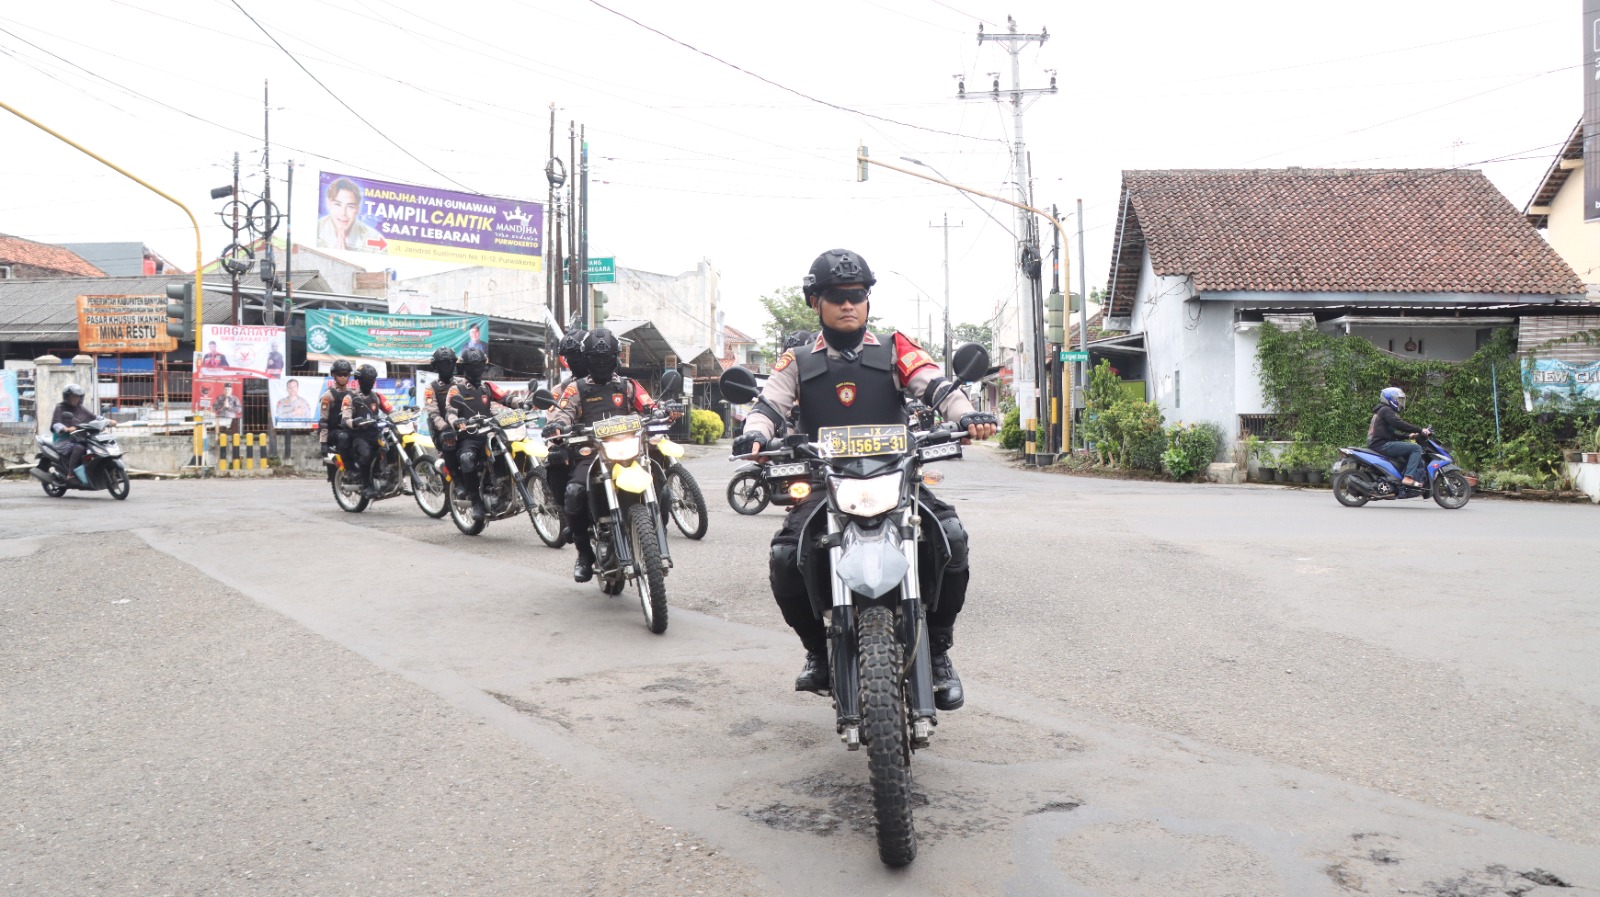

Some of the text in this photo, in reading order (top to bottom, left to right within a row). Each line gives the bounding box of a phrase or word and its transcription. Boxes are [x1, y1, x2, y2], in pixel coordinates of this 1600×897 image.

[365, 188, 497, 214] MANDJHA IVAN GUNAWAN
[365, 201, 494, 232] TAMPIL CANTIK
[382, 222, 480, 244] SAAT LEBARAN
[496, 223, 538, 235] MANDJHA
[494, 238, 539, 249] PURWOKERTO
[499, 257, 536, 267] Purwokerto
[117, 297, 143, 305] KABUPATEN
[86, 316, 168, 324] PASAR KHUSUS IKAN HIAS
[100, 325, 157, 339] MINA RESTU
[211, 326, 278, 337] DIRGAHAYU
[1532, 370, 1600, 384] NEW CLI
[870, 428, 881, 436] IX
[850, 436, 904, 453] 1565-31
